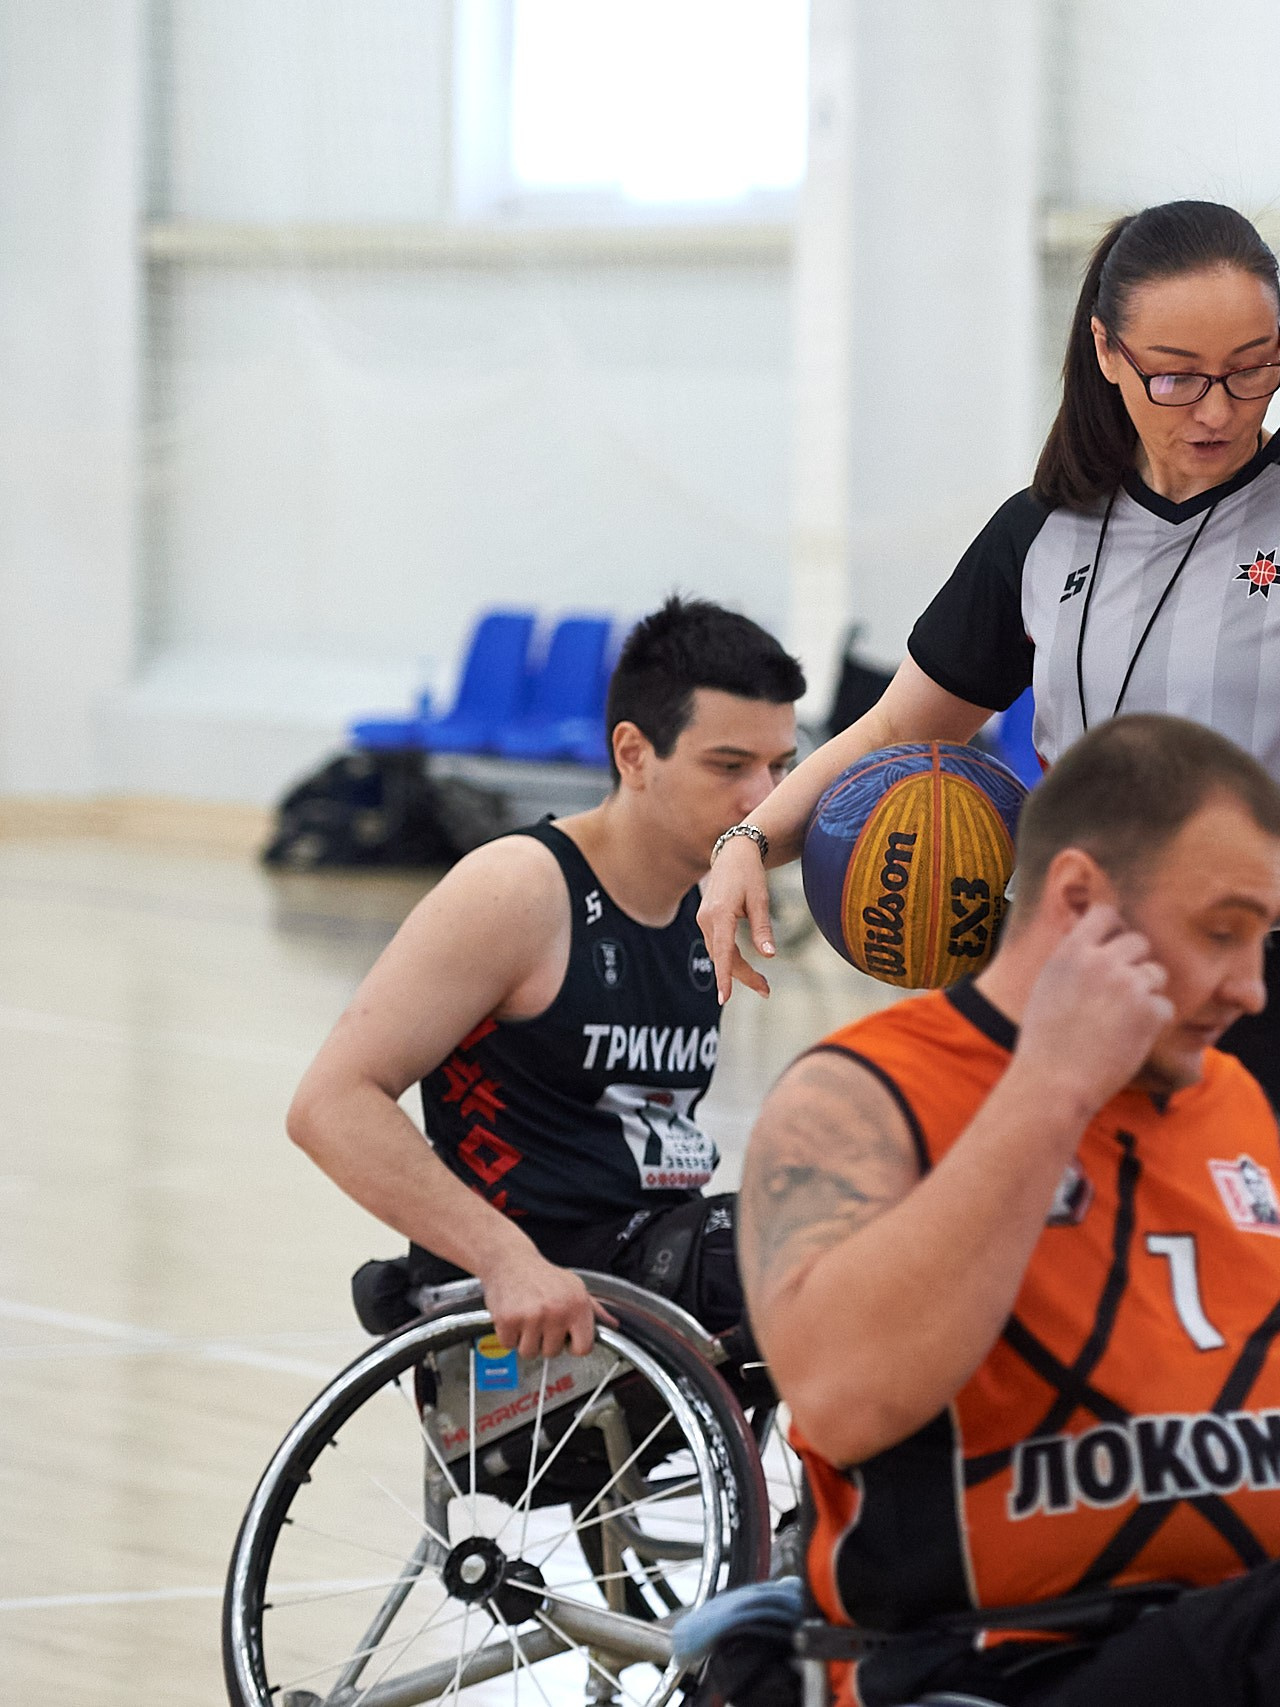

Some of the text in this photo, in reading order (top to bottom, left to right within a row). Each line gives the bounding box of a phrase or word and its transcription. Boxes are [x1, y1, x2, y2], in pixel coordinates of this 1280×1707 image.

[862, 831, 918, 977] Wilson
[582, 1024, 719, 1073] ТРИУМФ
[1145, 1231, 1226, 1352] 1
